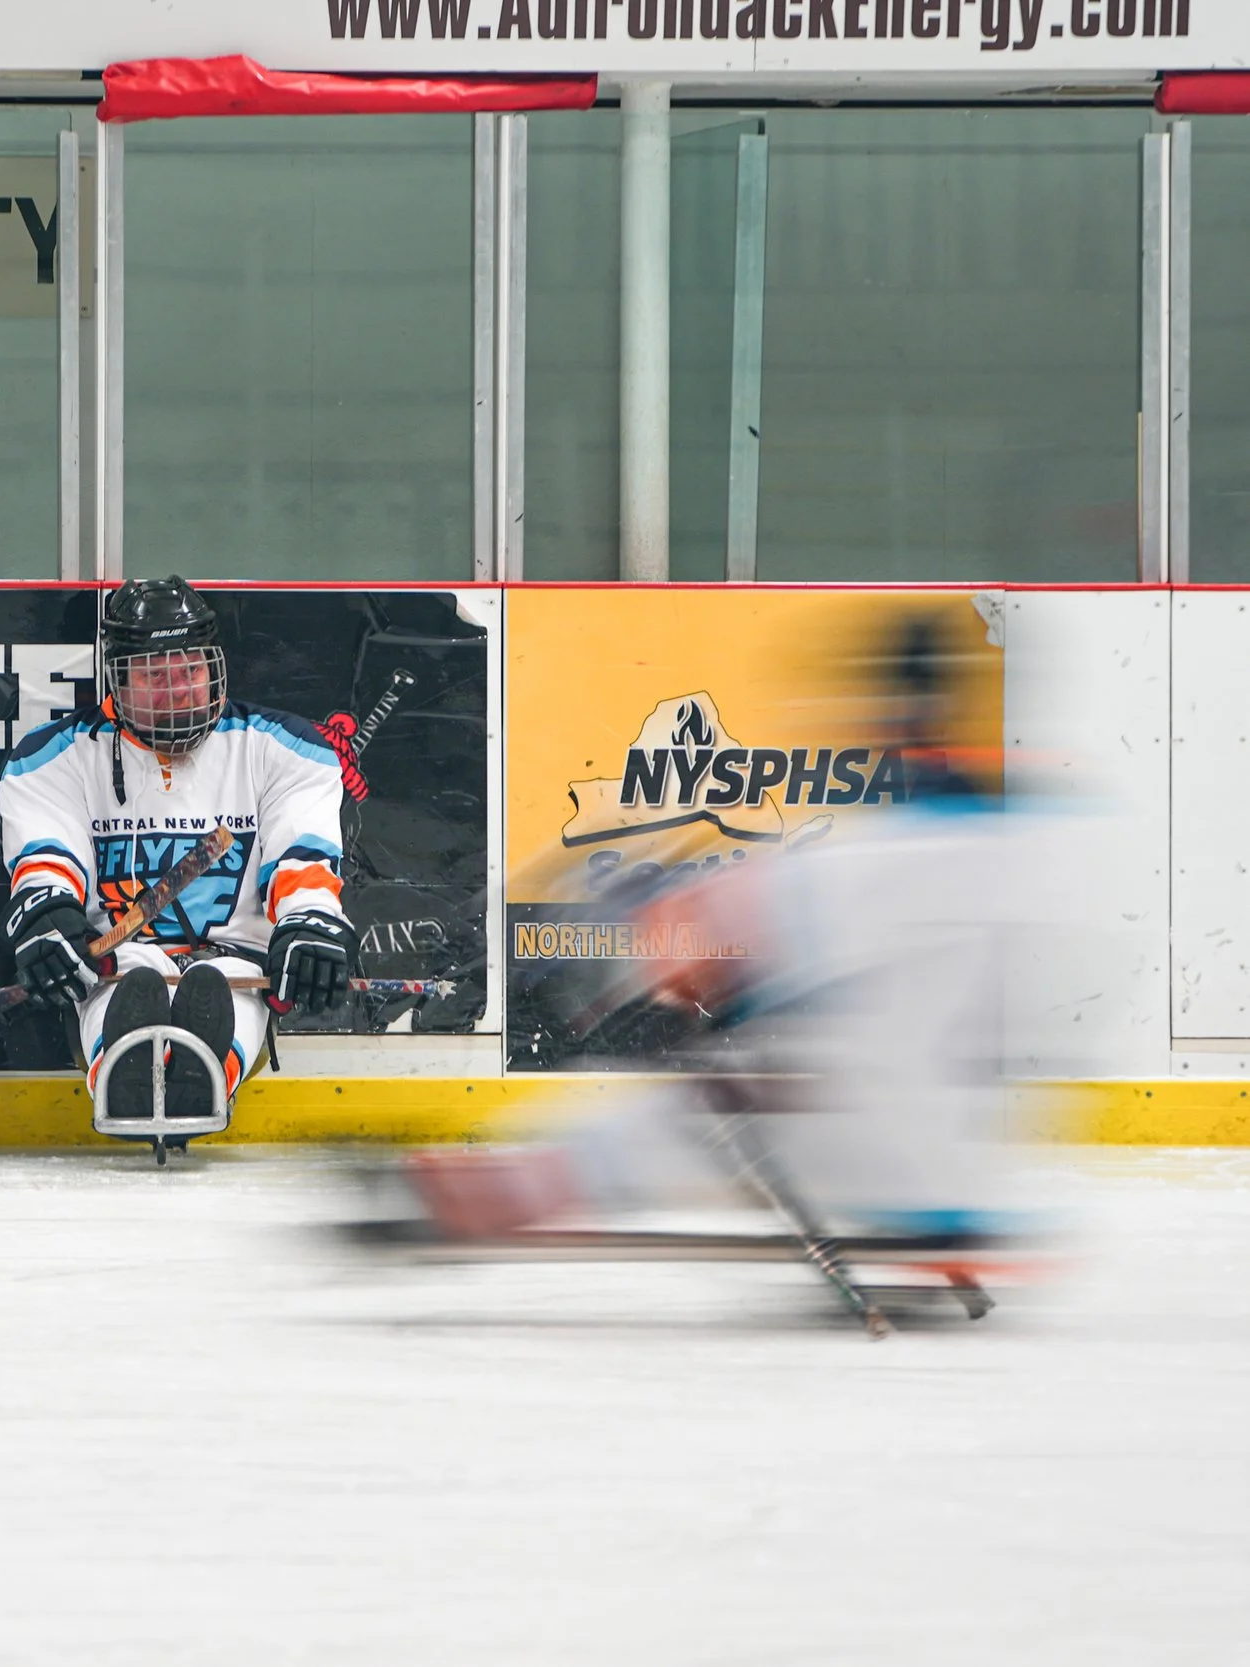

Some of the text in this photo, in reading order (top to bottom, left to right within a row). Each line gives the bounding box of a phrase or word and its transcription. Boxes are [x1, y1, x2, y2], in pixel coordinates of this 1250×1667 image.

[150, 627, 189, 639] BAUER
[165, 817, 207, 829] NEW
[214, 814, 257, 829] YORK
[513, 922, 671, 959] NORTHERN
